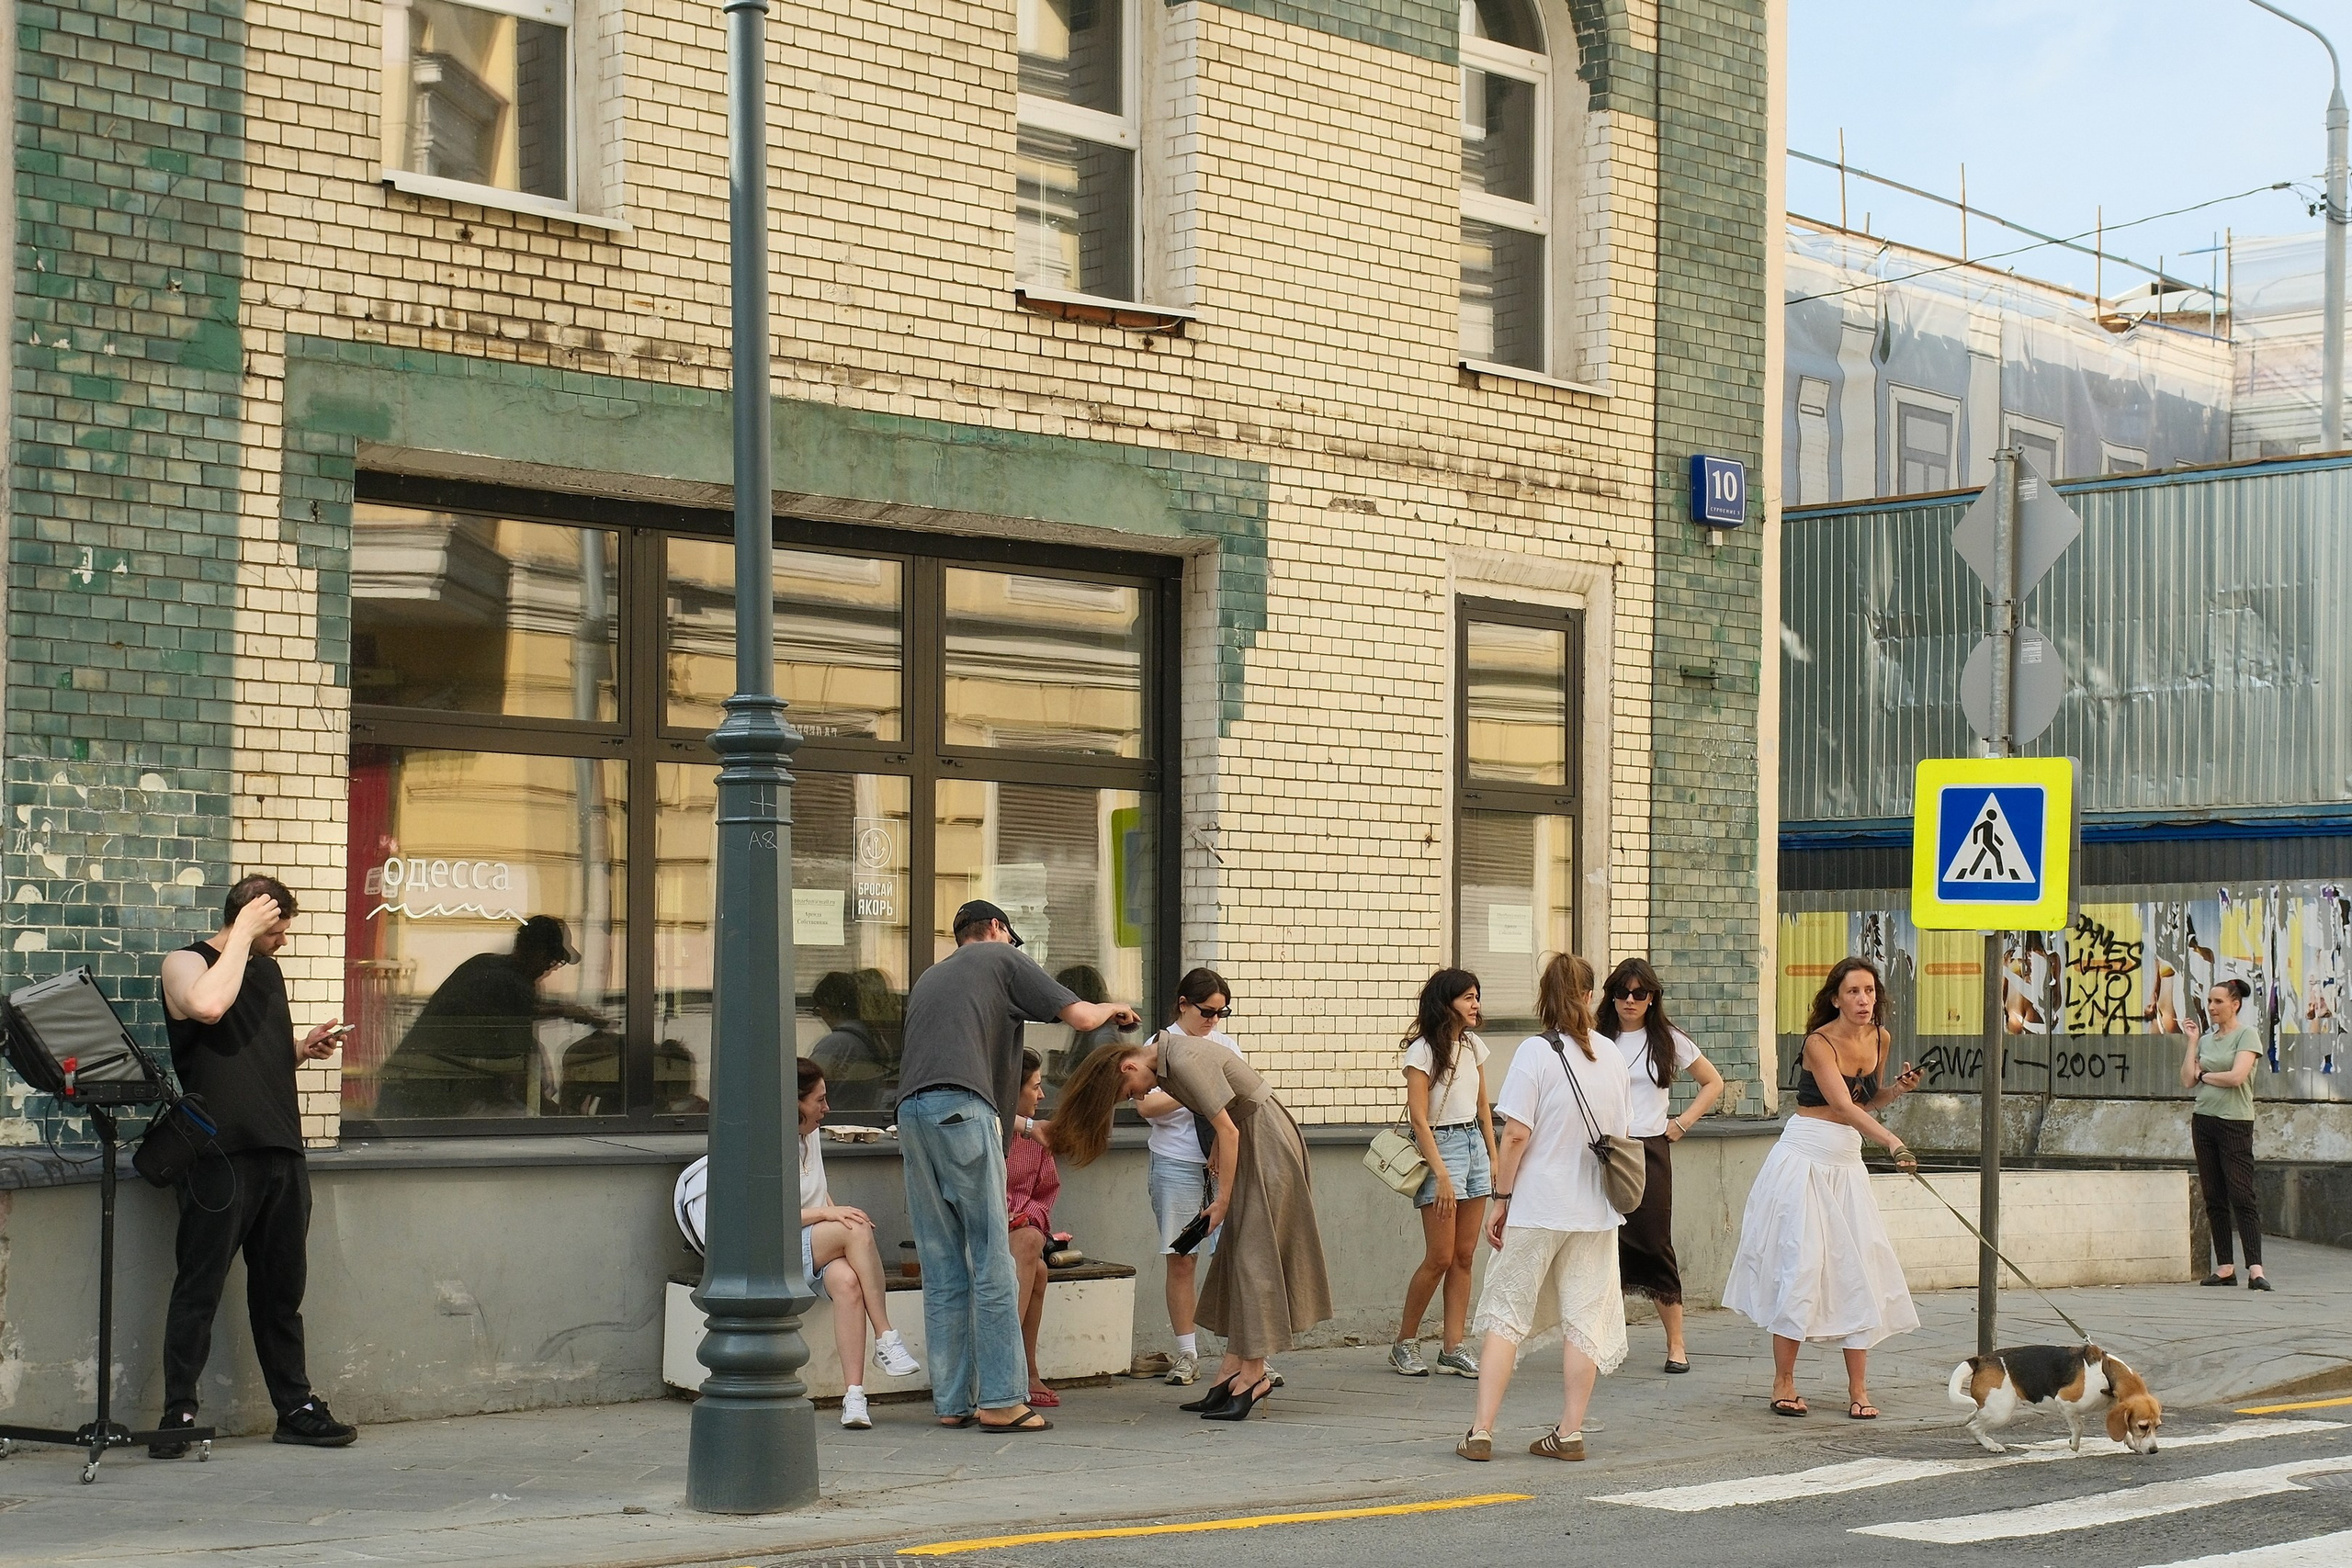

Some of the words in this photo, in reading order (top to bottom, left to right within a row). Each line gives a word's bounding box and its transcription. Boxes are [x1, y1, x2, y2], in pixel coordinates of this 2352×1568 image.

[1712, 469, 1737, 502] 10
[382, 856, 512, 893] одесса
[858, 881, 893, 897] БРОСАЙ
[857, 898, 893, 916] ЯКОРЬ
[2056, 1051, 2130, 1084] 2007
